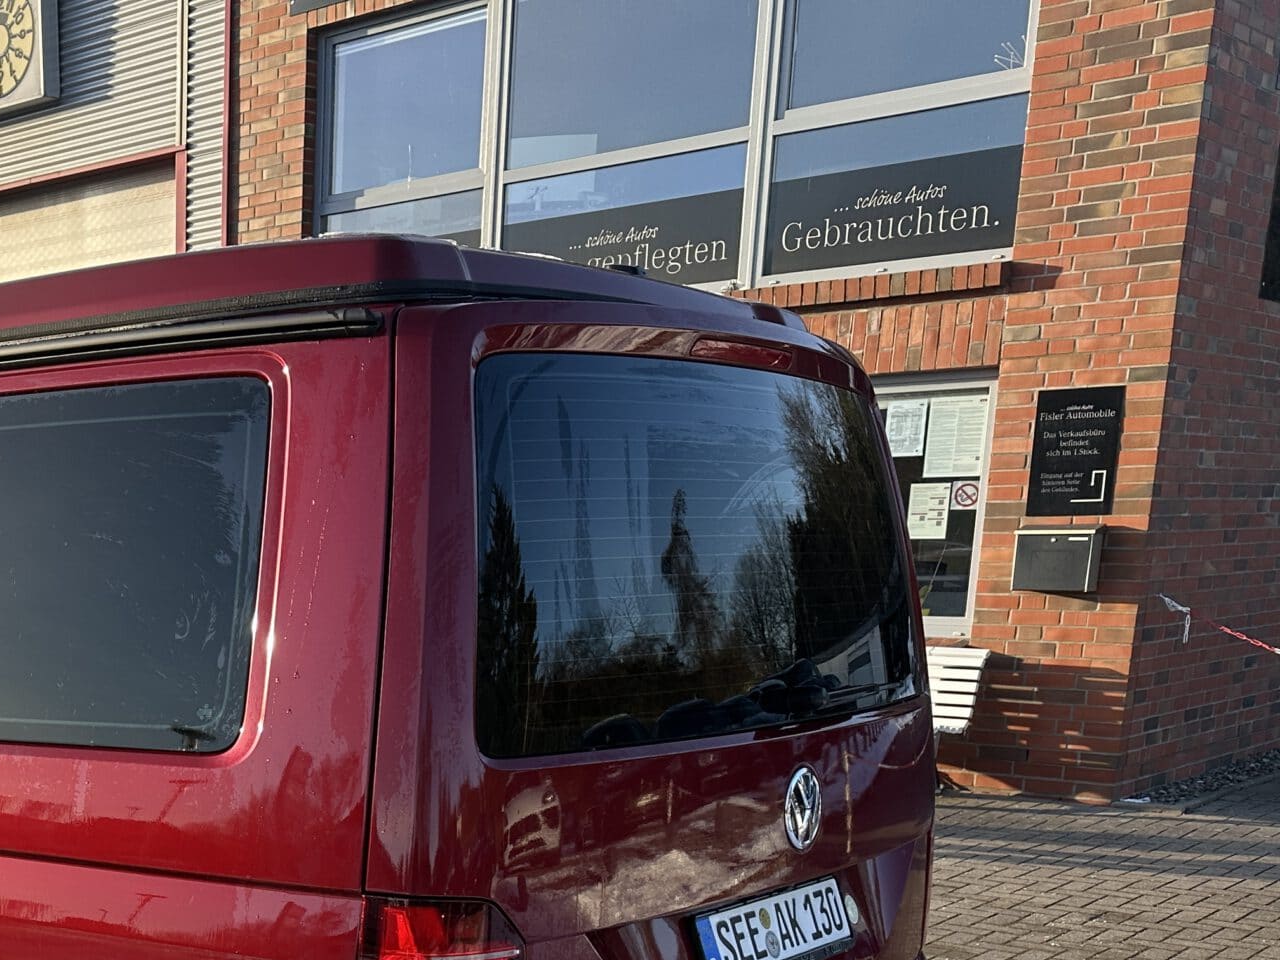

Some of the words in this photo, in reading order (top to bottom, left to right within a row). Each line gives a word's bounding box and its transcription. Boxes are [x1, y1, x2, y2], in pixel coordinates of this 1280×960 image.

[905, 184, 947, 204] Autos
[625, 225, 659, 243] Autos
[781, 203, 1000, 252] Gebrauchten.
[1066, 409, 1116, 420] Automobile
[1059, 429, 1106, 438] Verkaufsbüro
[1046, 449, 1061, 457] sich
[774, 897, 808, 951] AK
[803, 886, 844, 941] 130
